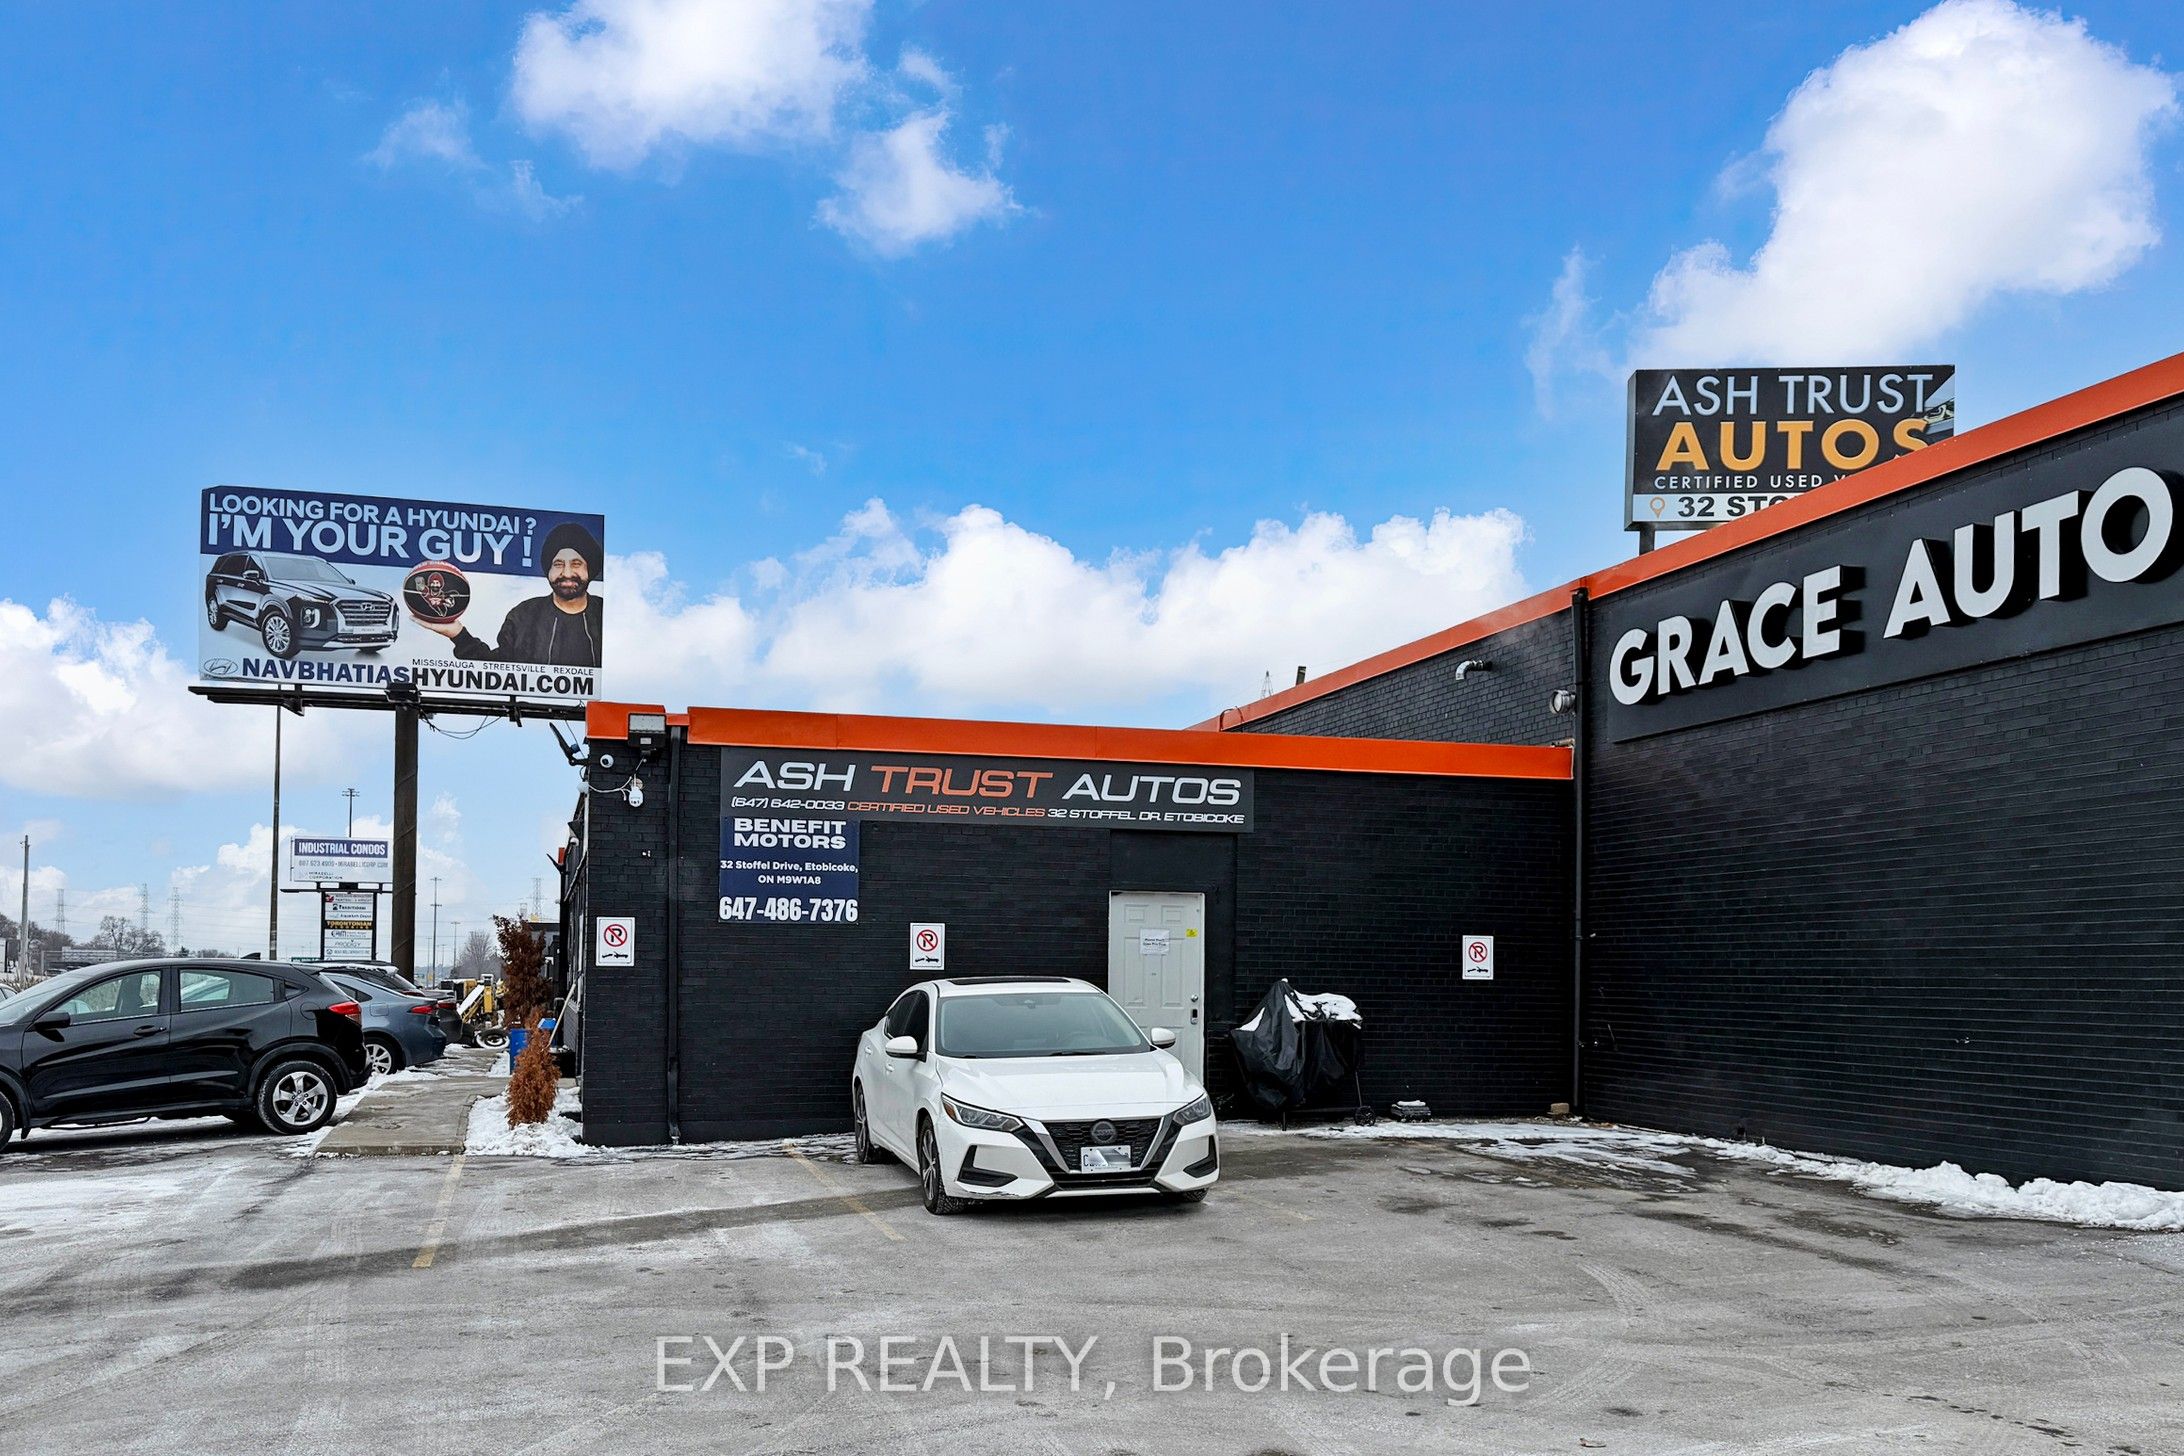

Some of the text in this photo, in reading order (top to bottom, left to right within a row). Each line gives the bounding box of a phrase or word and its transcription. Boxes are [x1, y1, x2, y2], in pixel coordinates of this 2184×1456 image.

[1651, 373, 1933, 416] ASH TRUST
[1654, 475, 1758, 490] CERTIFIED
[1770, 475, 1823, 488] USED
[209, 493, 324, 519] LOOKING
[329, 502, 380, 524] FOR
[383, 506, 403, 526] A
[407, 508, 520, 535] HYUNDAI
[1677, 496, 1715, 517] 32
[208, 513, 272, 549] I'M
[283, 518, 410, 559] YOUR
[418, 528, 514, 565] GUY
[1609, 467, 2174, 705] GRACE AUTO
[412, 658, 594, 676] MISSISSAUGA STREETSVILLE REXDALE
[733, 760, 1241, 806] ASH TRUST AUTOS
[731, 796, 768, 809] (647)
[770, 798, 845, 811] 642-0033
[847, 801, 925, 813] CERTIFIED
[927, 804, 970, 815] USED
[973, 805, 1046, 817] VEHICLES
[1047, 808, 1068, 818] 32
[1068, 809, 1136, 820] STOFFEL
[1163, 812, 1245, 824] ETOBICOKE
[733, 817, 847, 835] BENEFIT
[298, 842, 386, 855] INDUSTRIAL CONDOS
[733, 833, 847, 850] MOTORS
[720, 860, 859, 873] 32 Stoffel Drive, Etobicoke,
[757, 875, 822, 885] ON M9W1A8
[719, 896, 859, 922] 647-486-7376
